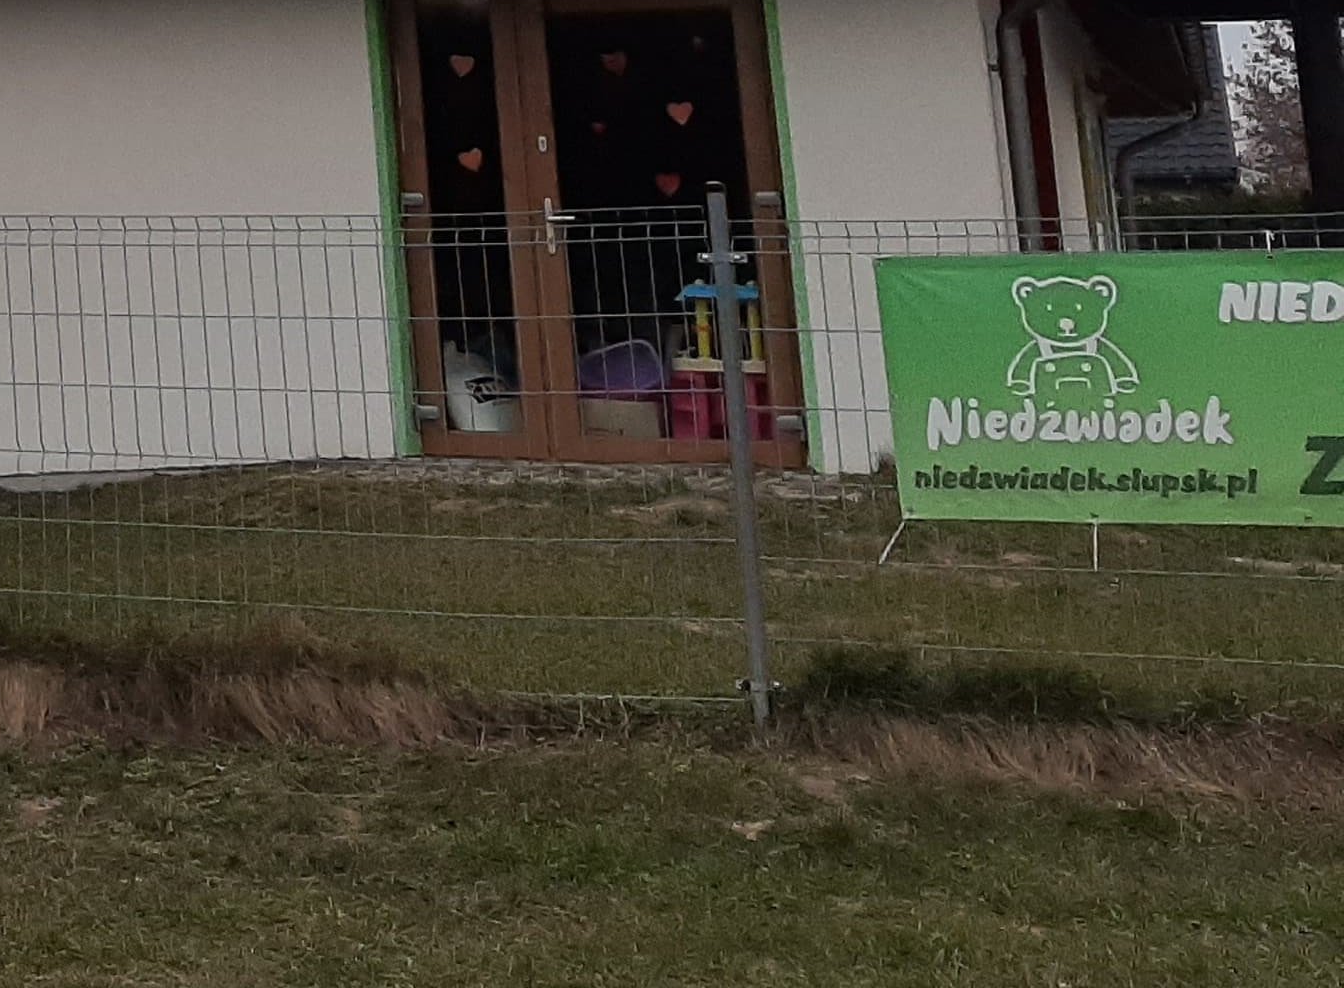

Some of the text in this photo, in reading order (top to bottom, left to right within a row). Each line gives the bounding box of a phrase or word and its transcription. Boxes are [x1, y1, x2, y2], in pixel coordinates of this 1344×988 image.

[1218, 280, 1344, 323] NIED
[927, 396, 1234, 450] Niedźwiadek
[914, 465, 1258, 498] niedzwiadek.slupsk.pl
